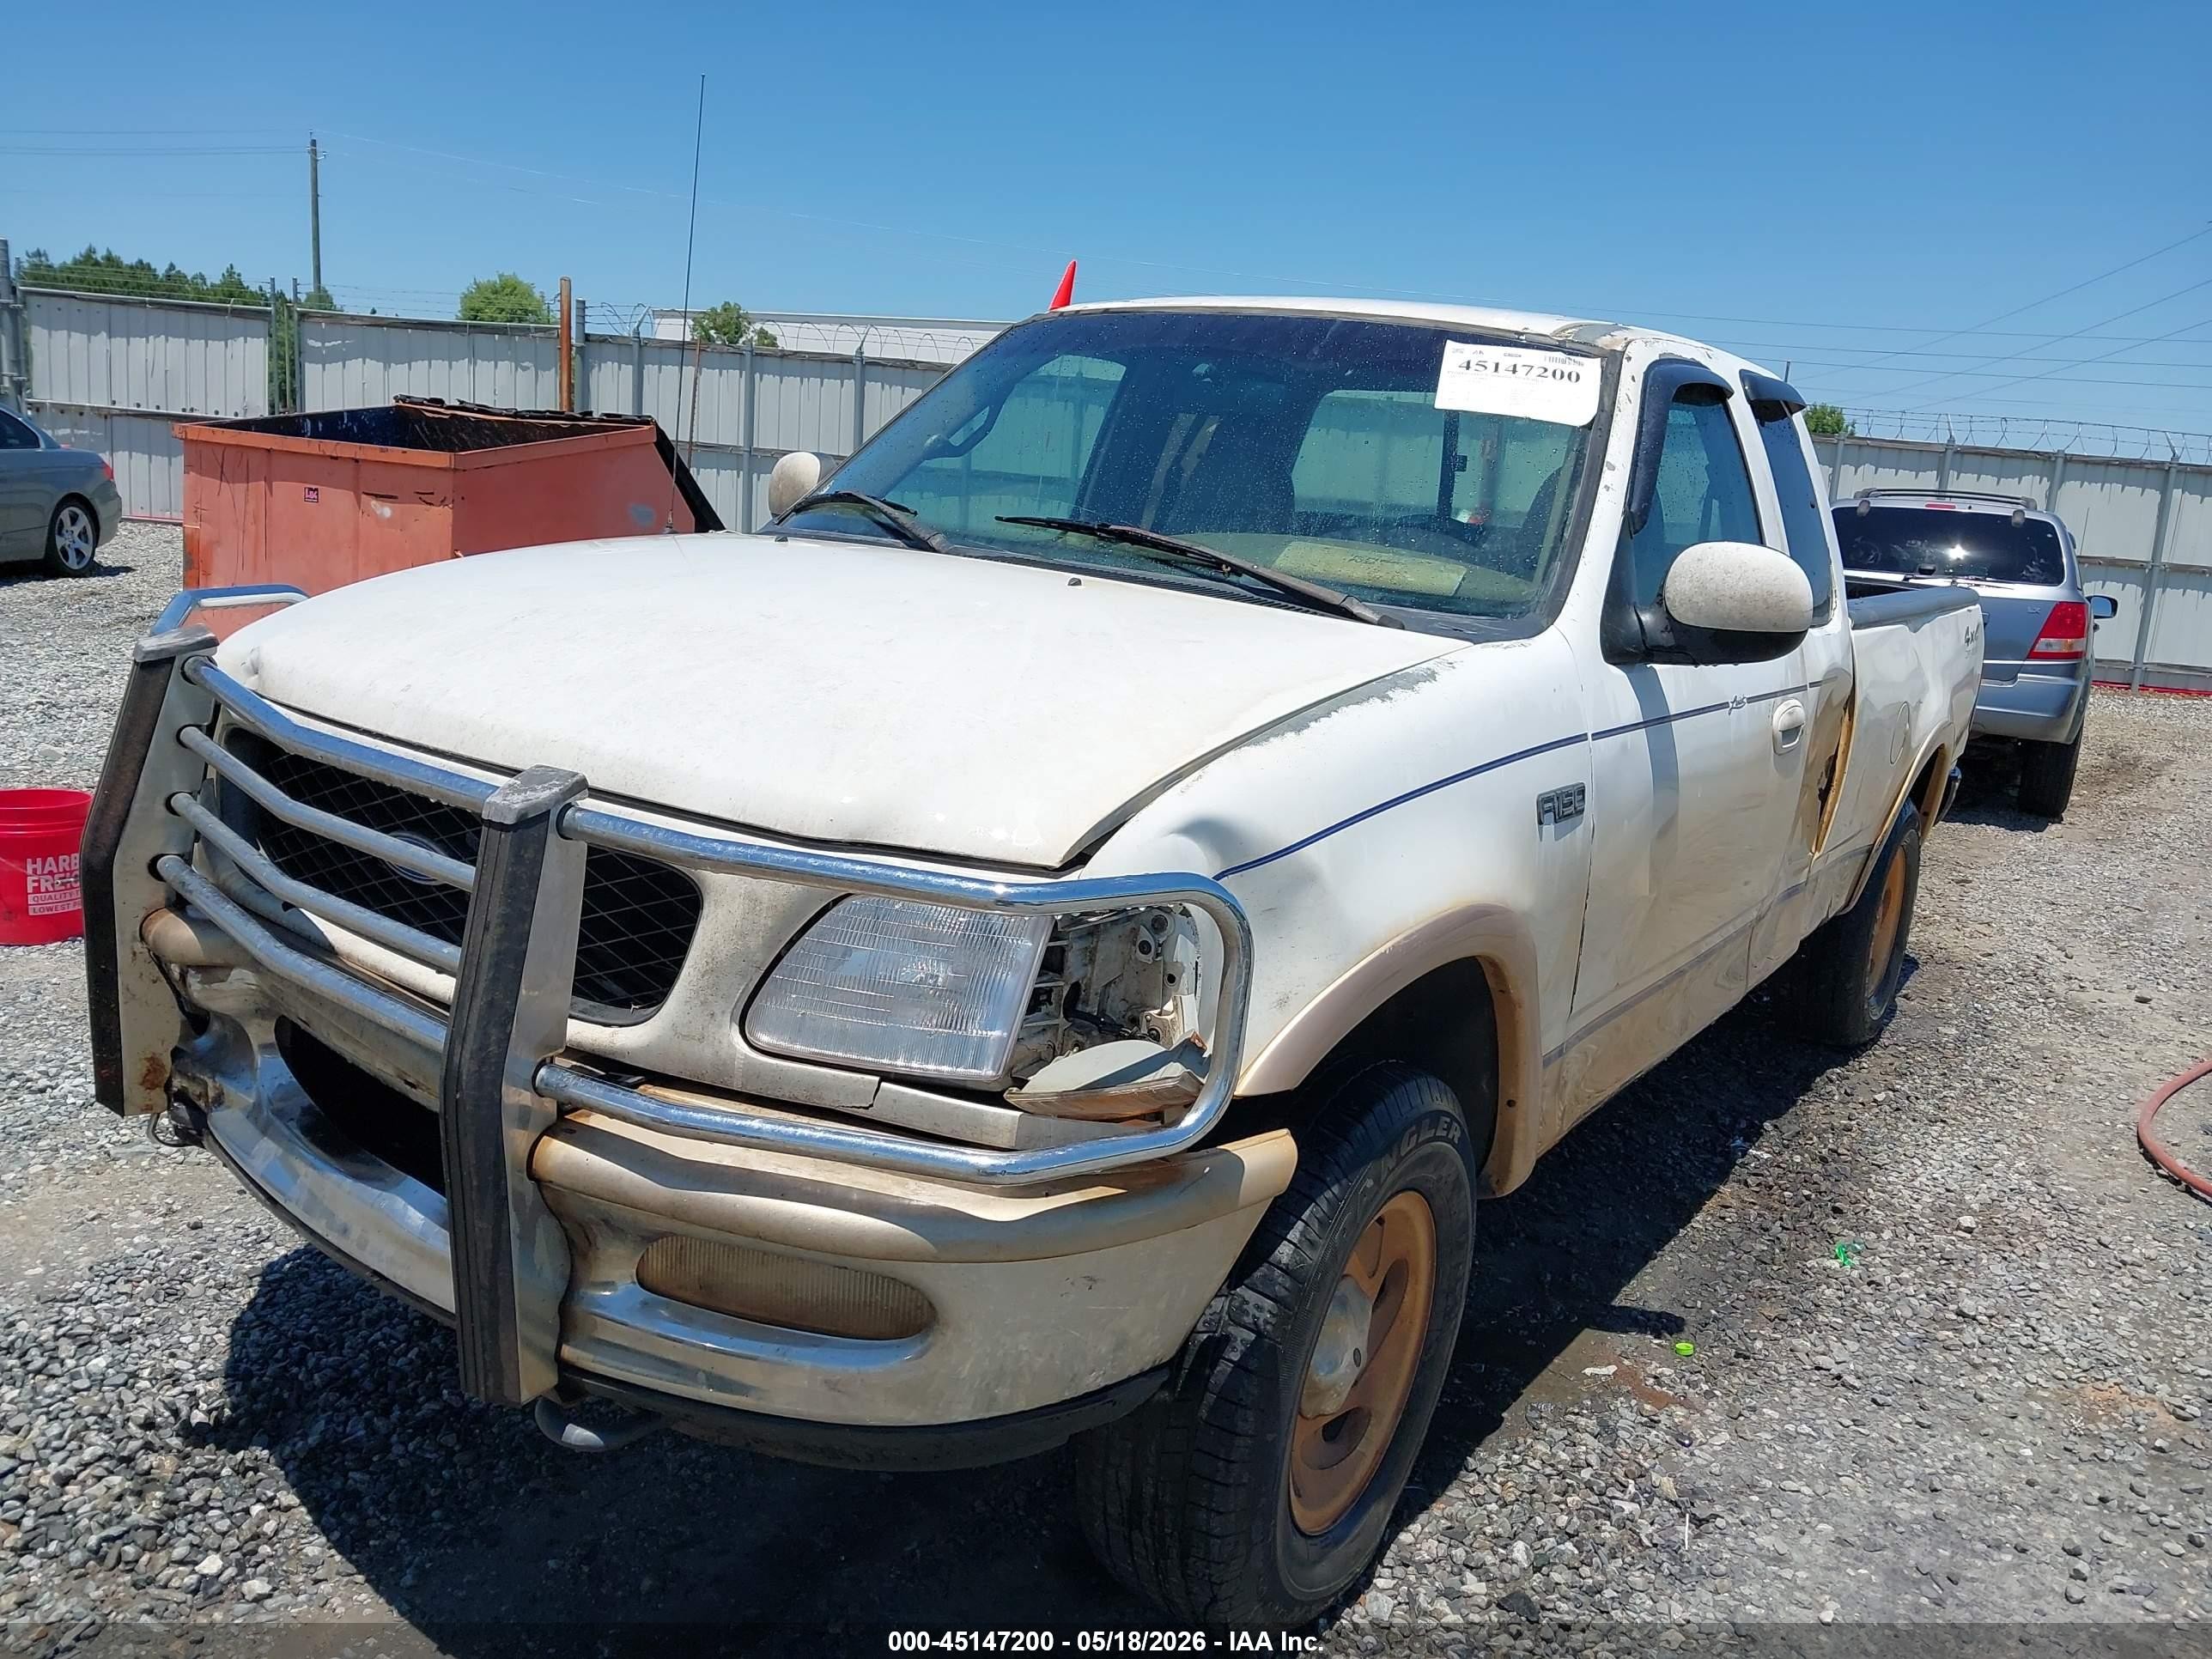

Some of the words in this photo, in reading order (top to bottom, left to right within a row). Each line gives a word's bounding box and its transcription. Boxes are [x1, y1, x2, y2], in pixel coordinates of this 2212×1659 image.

[1457, 359, 1582, 384] 45147200
[33, 890, 73, 902] QUALITY
[33, 902, 71, 914] LOWEST
